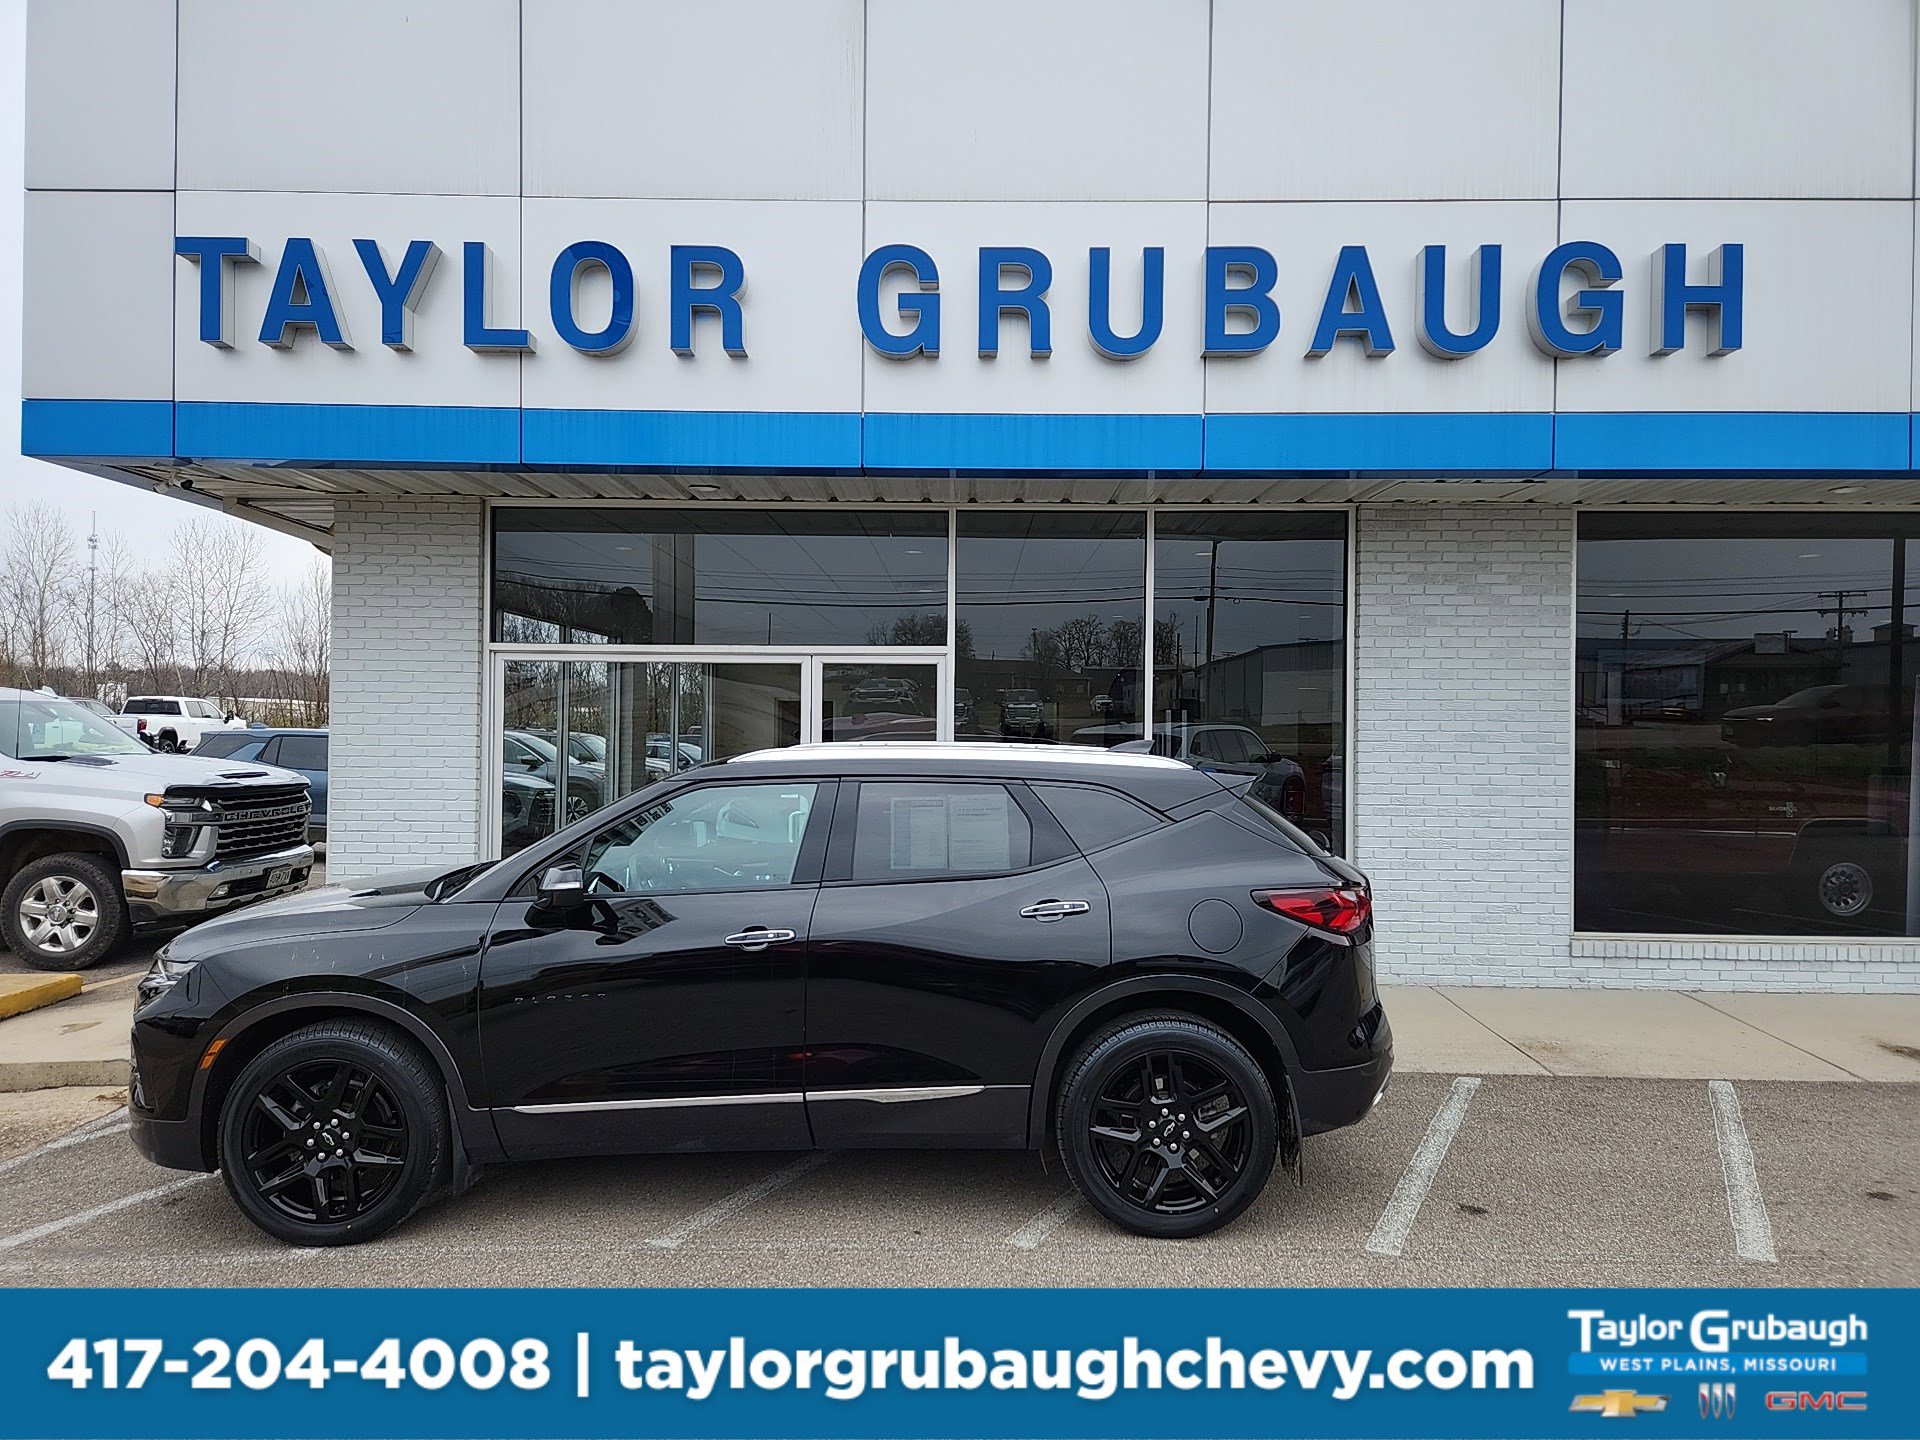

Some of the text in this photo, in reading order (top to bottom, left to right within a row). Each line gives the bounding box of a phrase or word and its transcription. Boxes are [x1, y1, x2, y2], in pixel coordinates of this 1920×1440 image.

[174, 236, 1745, 358] TAYLOR GRUBAUGH
[224, 804, 311, 822] CHEVROLET
